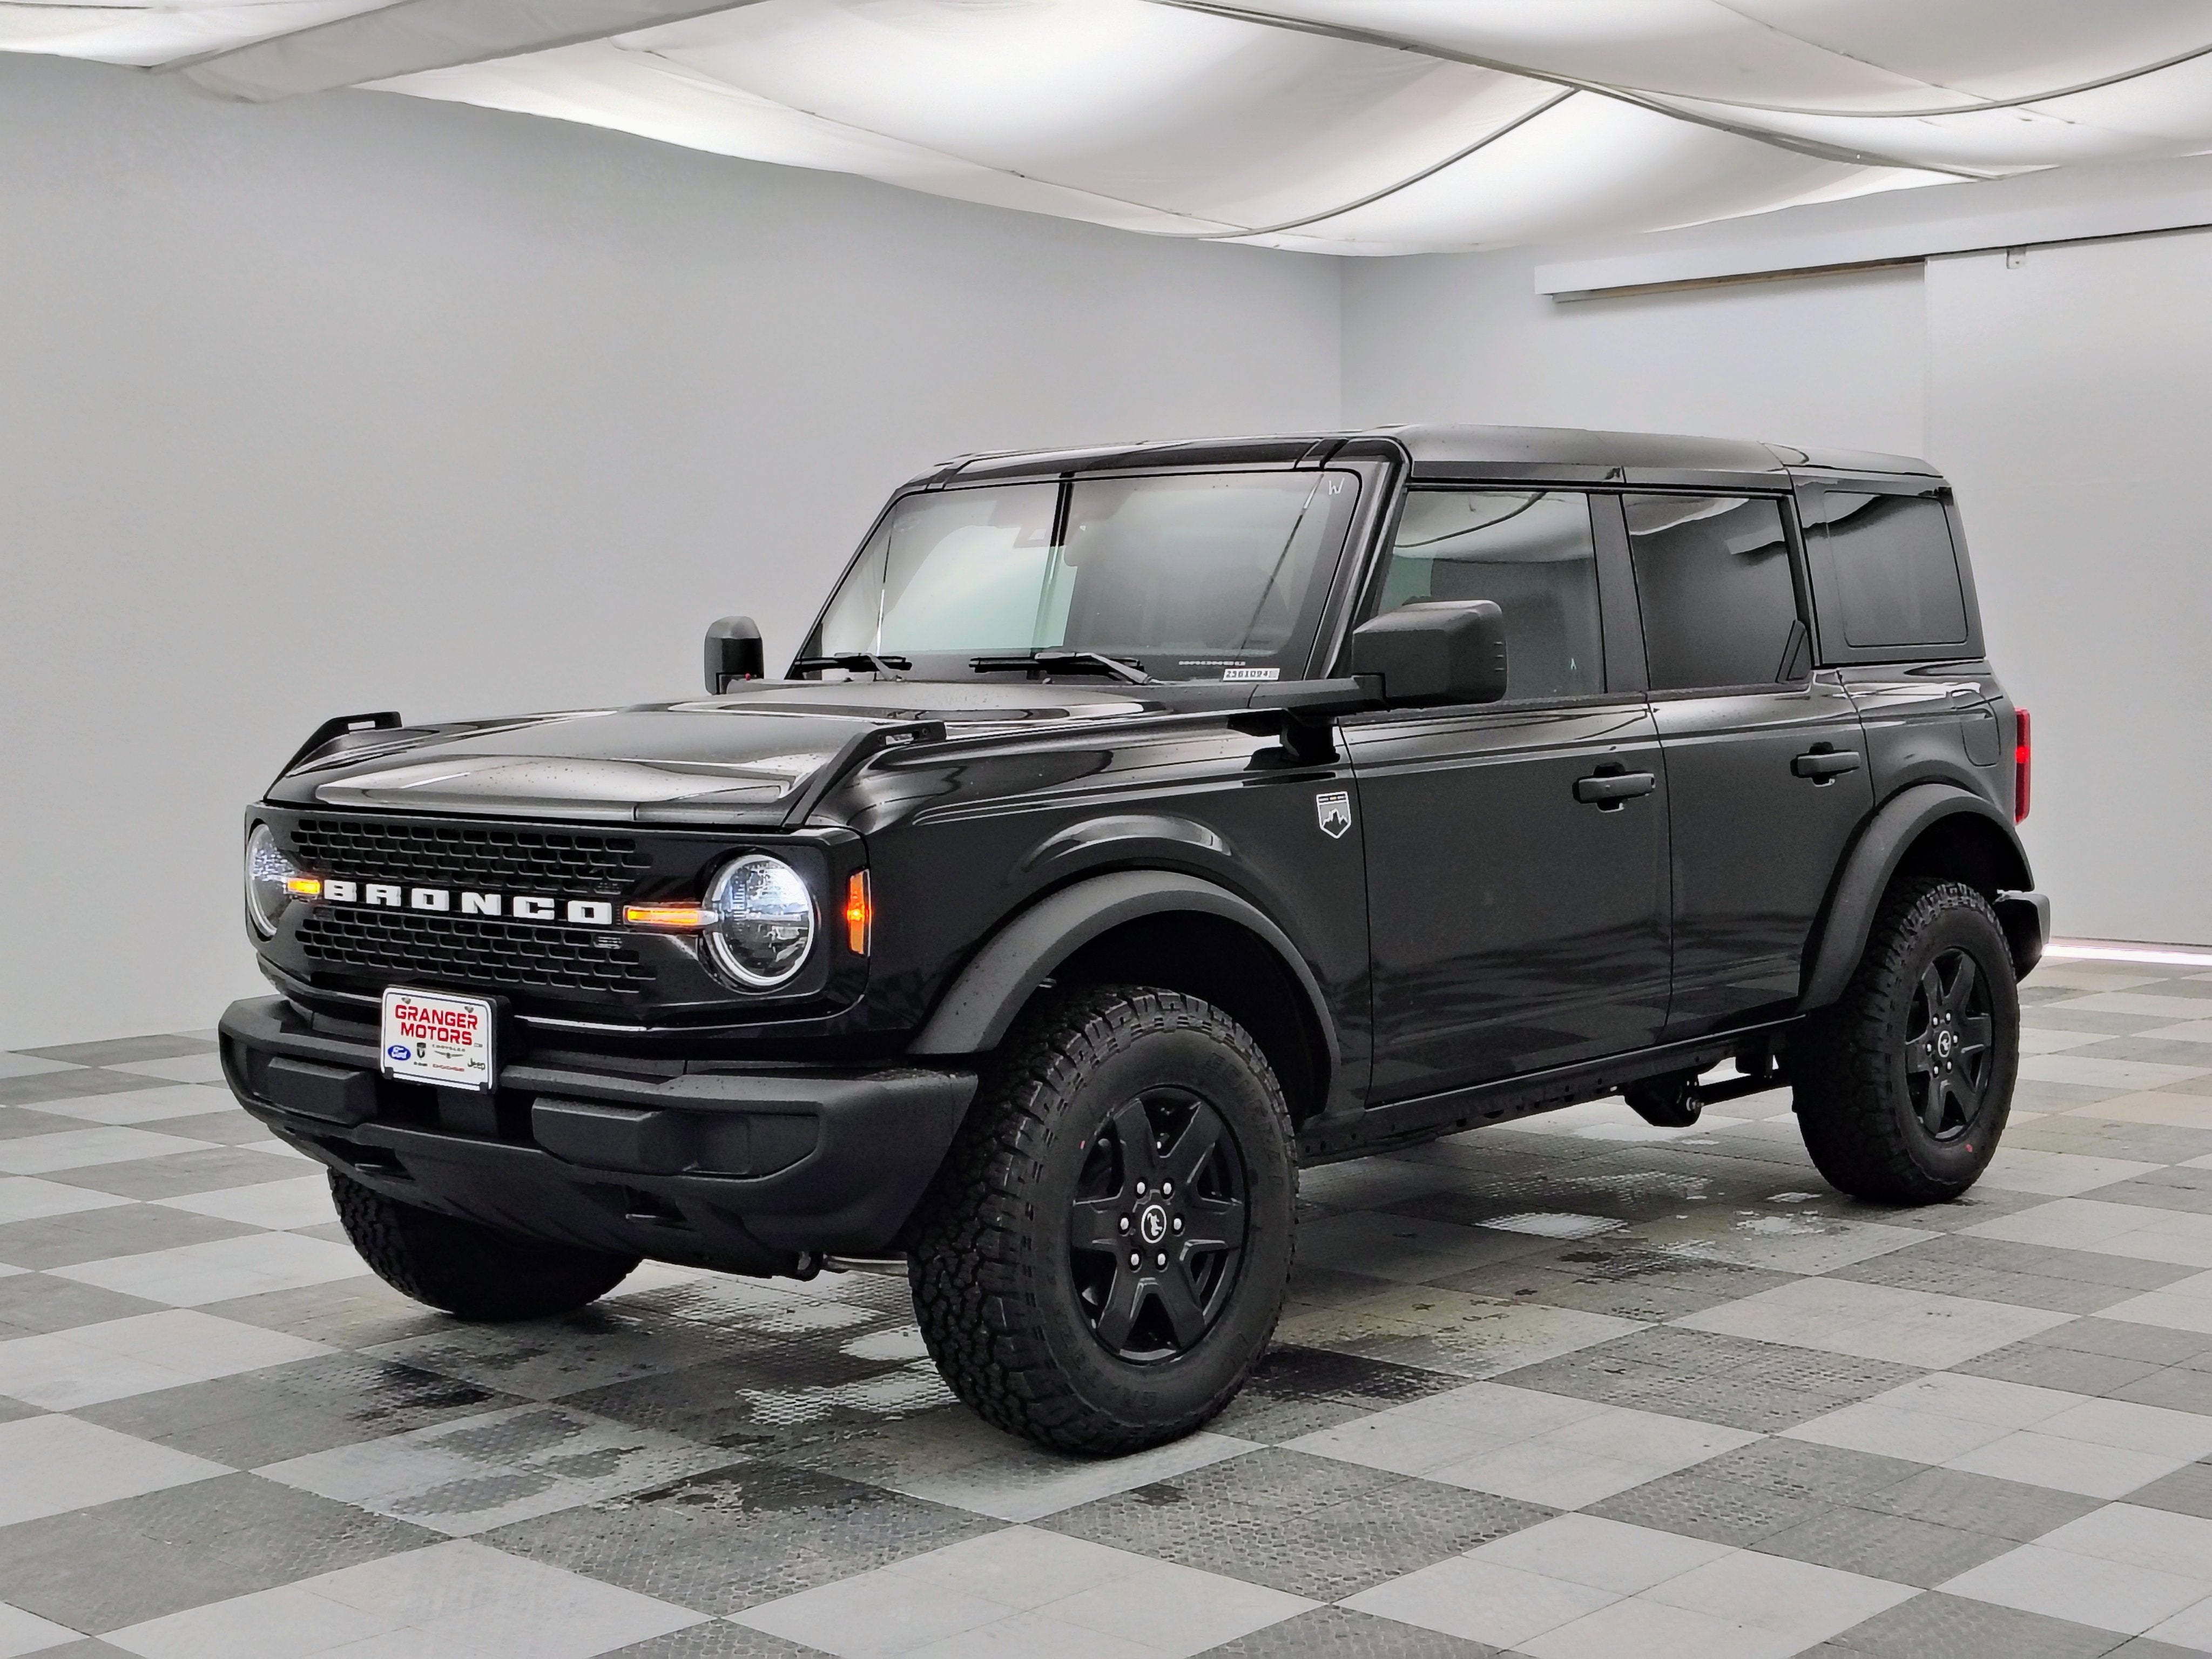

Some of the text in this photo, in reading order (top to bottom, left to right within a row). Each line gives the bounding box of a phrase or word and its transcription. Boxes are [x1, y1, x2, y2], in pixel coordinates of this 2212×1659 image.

[324, 879, 612, 925] BRONCO
[395, 1004, 478, 1030] GRANGER
[401, 1022, 473, 1046] MOTORS
